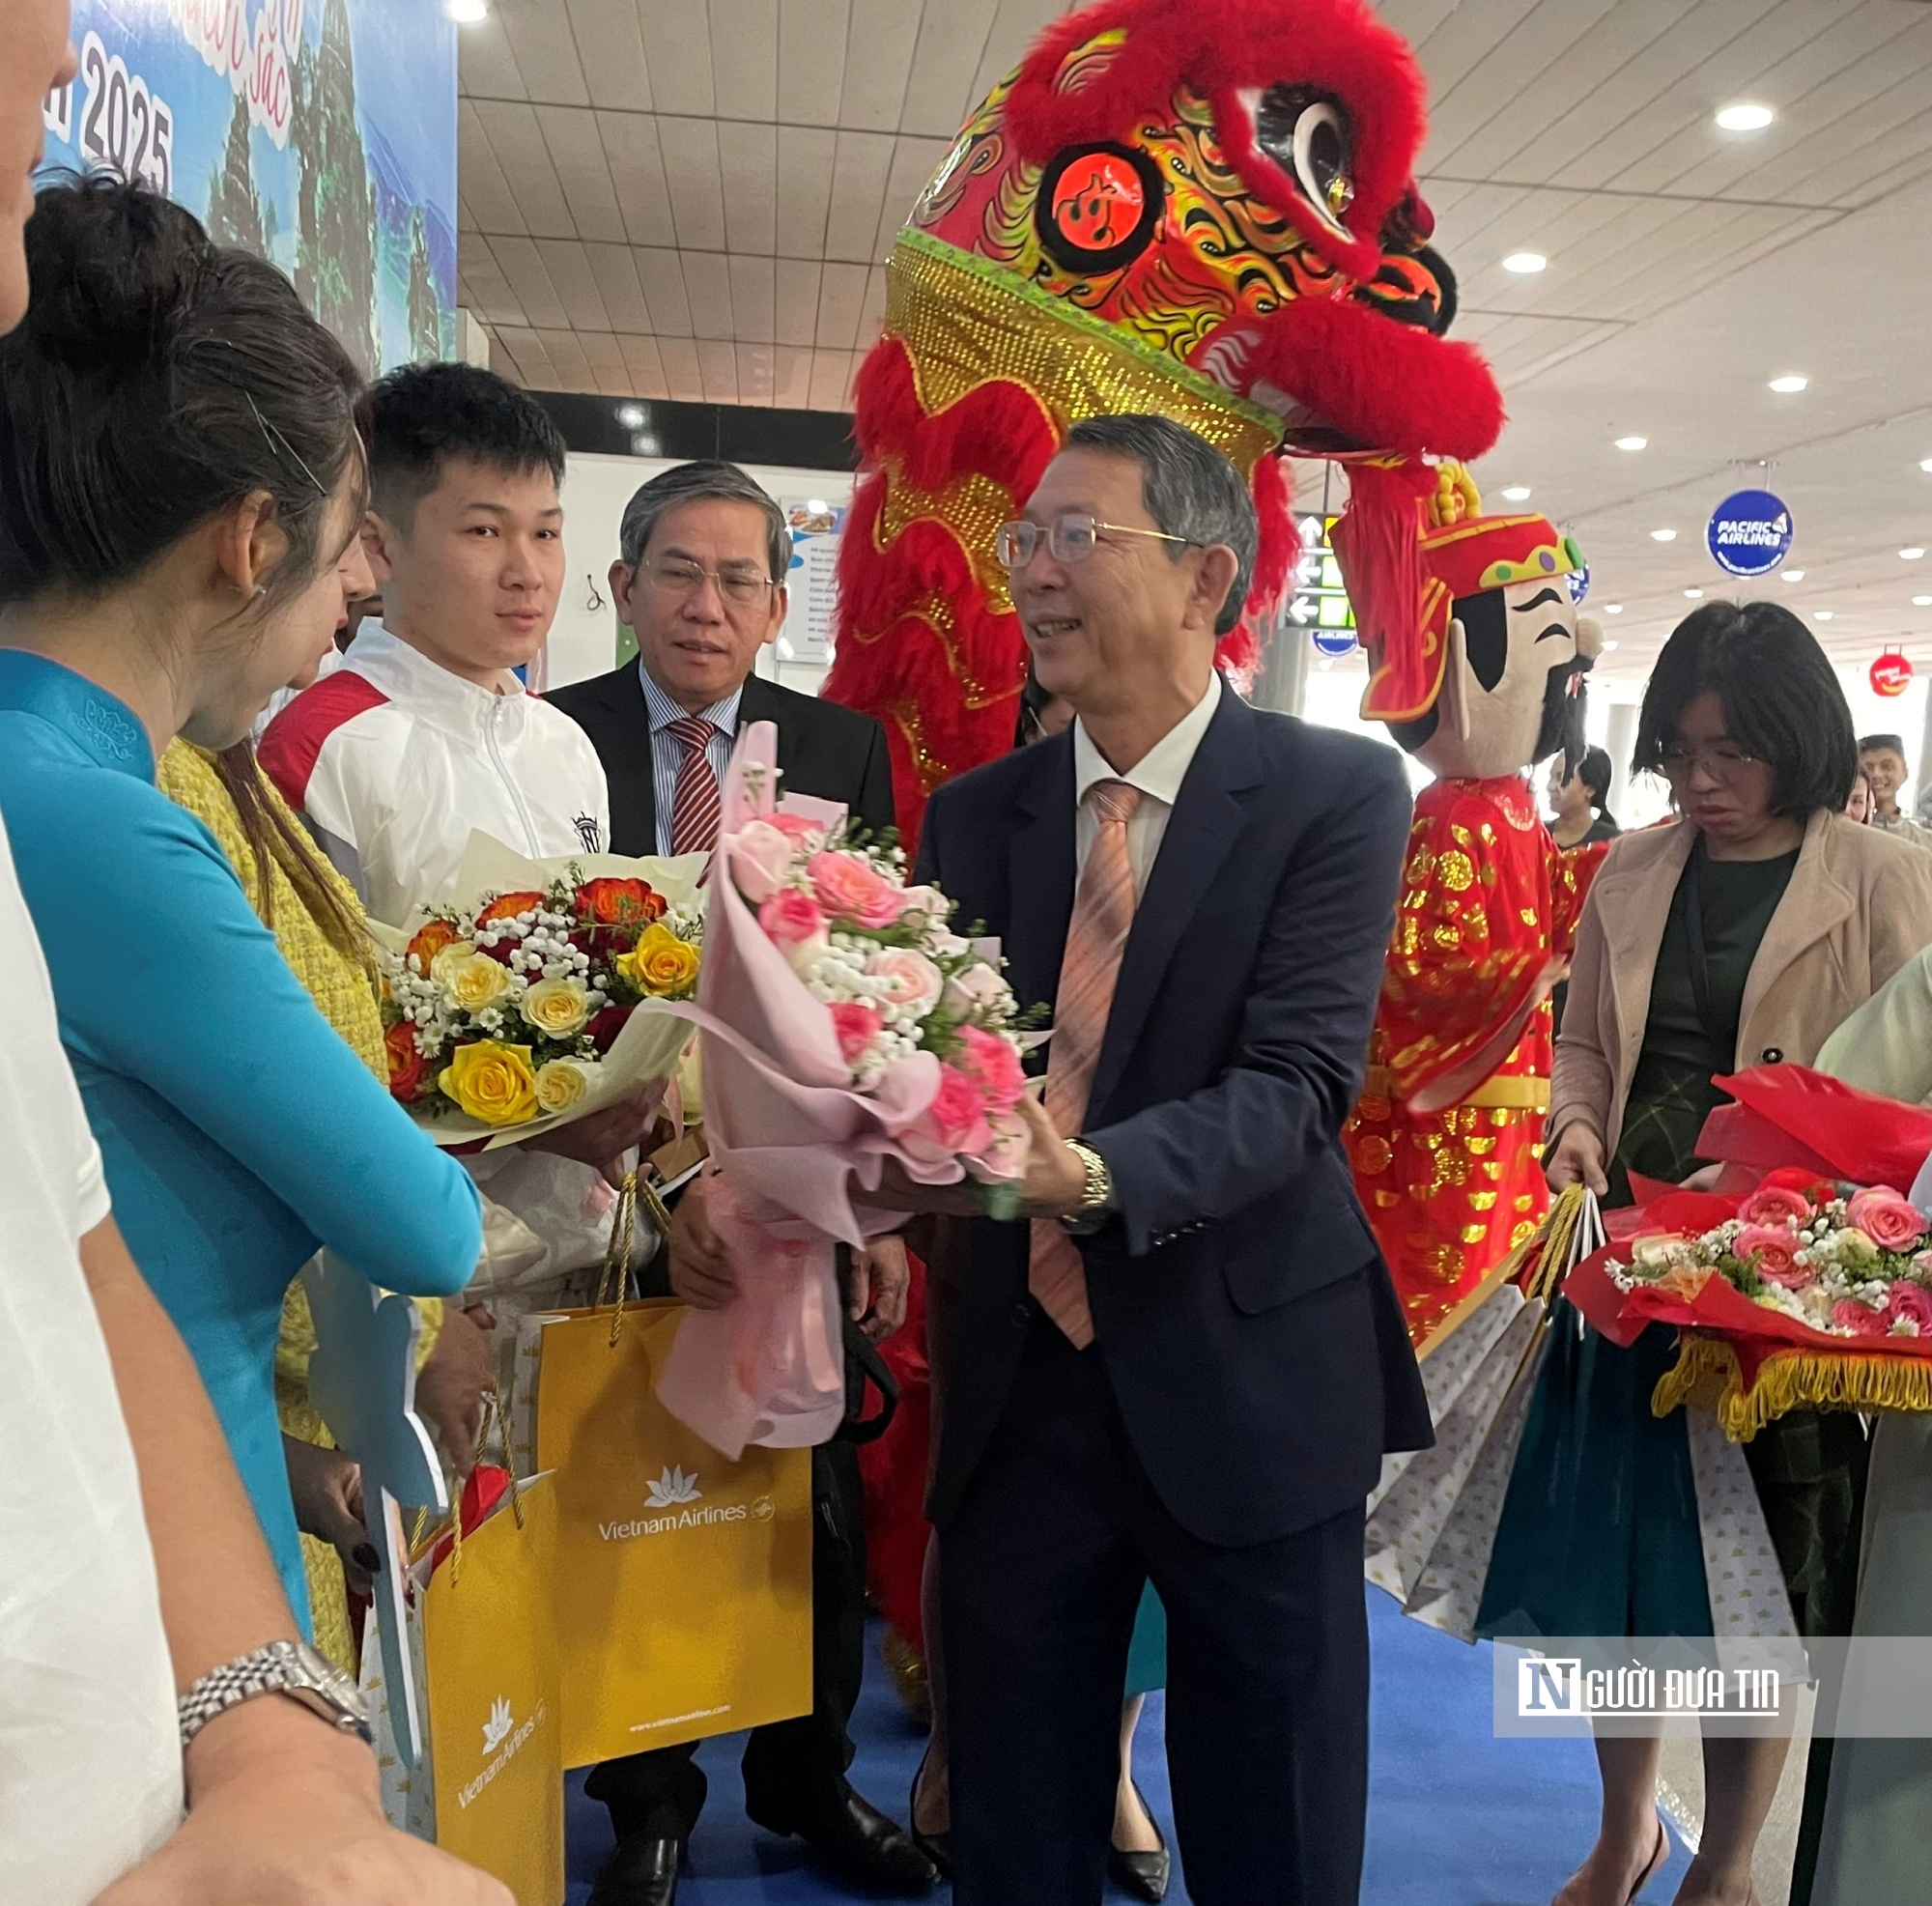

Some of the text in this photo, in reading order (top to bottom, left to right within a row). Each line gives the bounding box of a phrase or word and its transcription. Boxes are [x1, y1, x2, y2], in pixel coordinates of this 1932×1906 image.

[84, 46, 170, 199] 2025
[1718, 520, 1772, 533] PACIFIC
[1718, 532, 1781, 546] AIRLINES
[598, 1517, 677, 1541] Vietnam
[678, 1504, 747, 1529] Airlines
[458, 1753, 507, 1809] Vietnam
